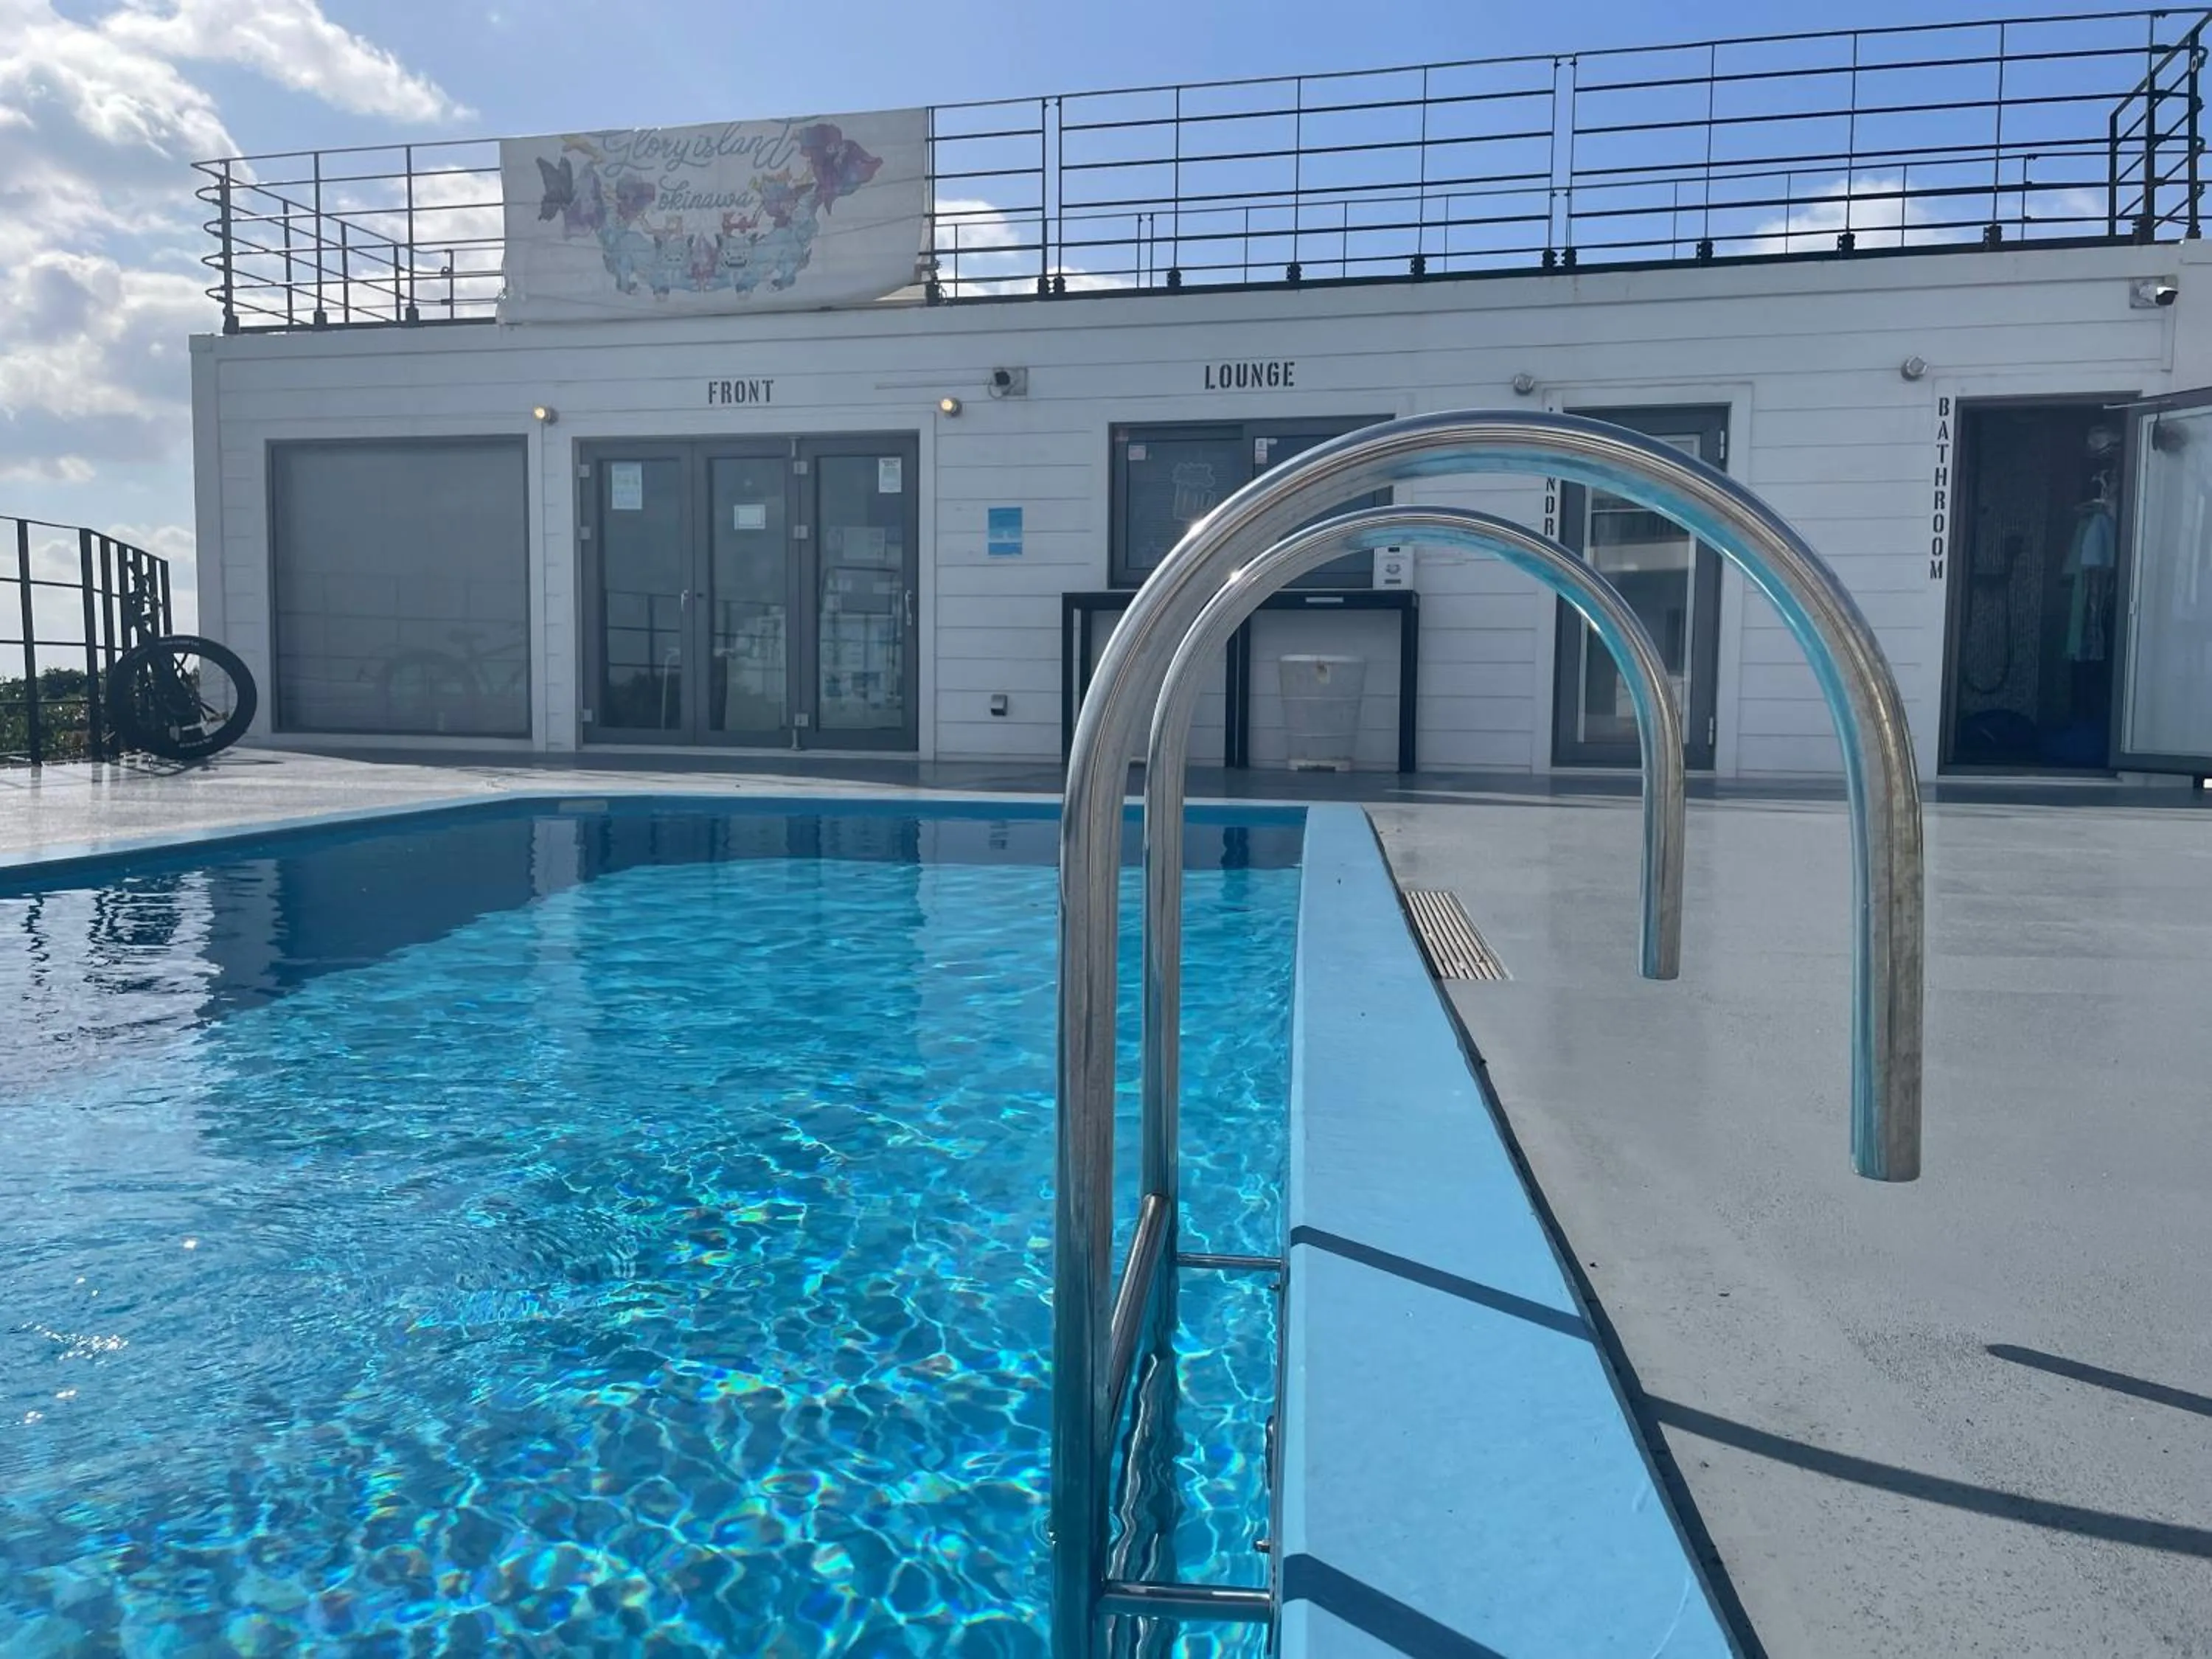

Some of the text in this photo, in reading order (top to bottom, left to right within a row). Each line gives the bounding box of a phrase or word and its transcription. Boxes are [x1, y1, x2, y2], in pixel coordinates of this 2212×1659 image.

[592, 118, 795, 178] Glory island
[709, 379, 775, 404] FRONT
[1205, 361, 1295, 390] LOUNGE
[1930, 397, 1950, 580] BATHROOM
